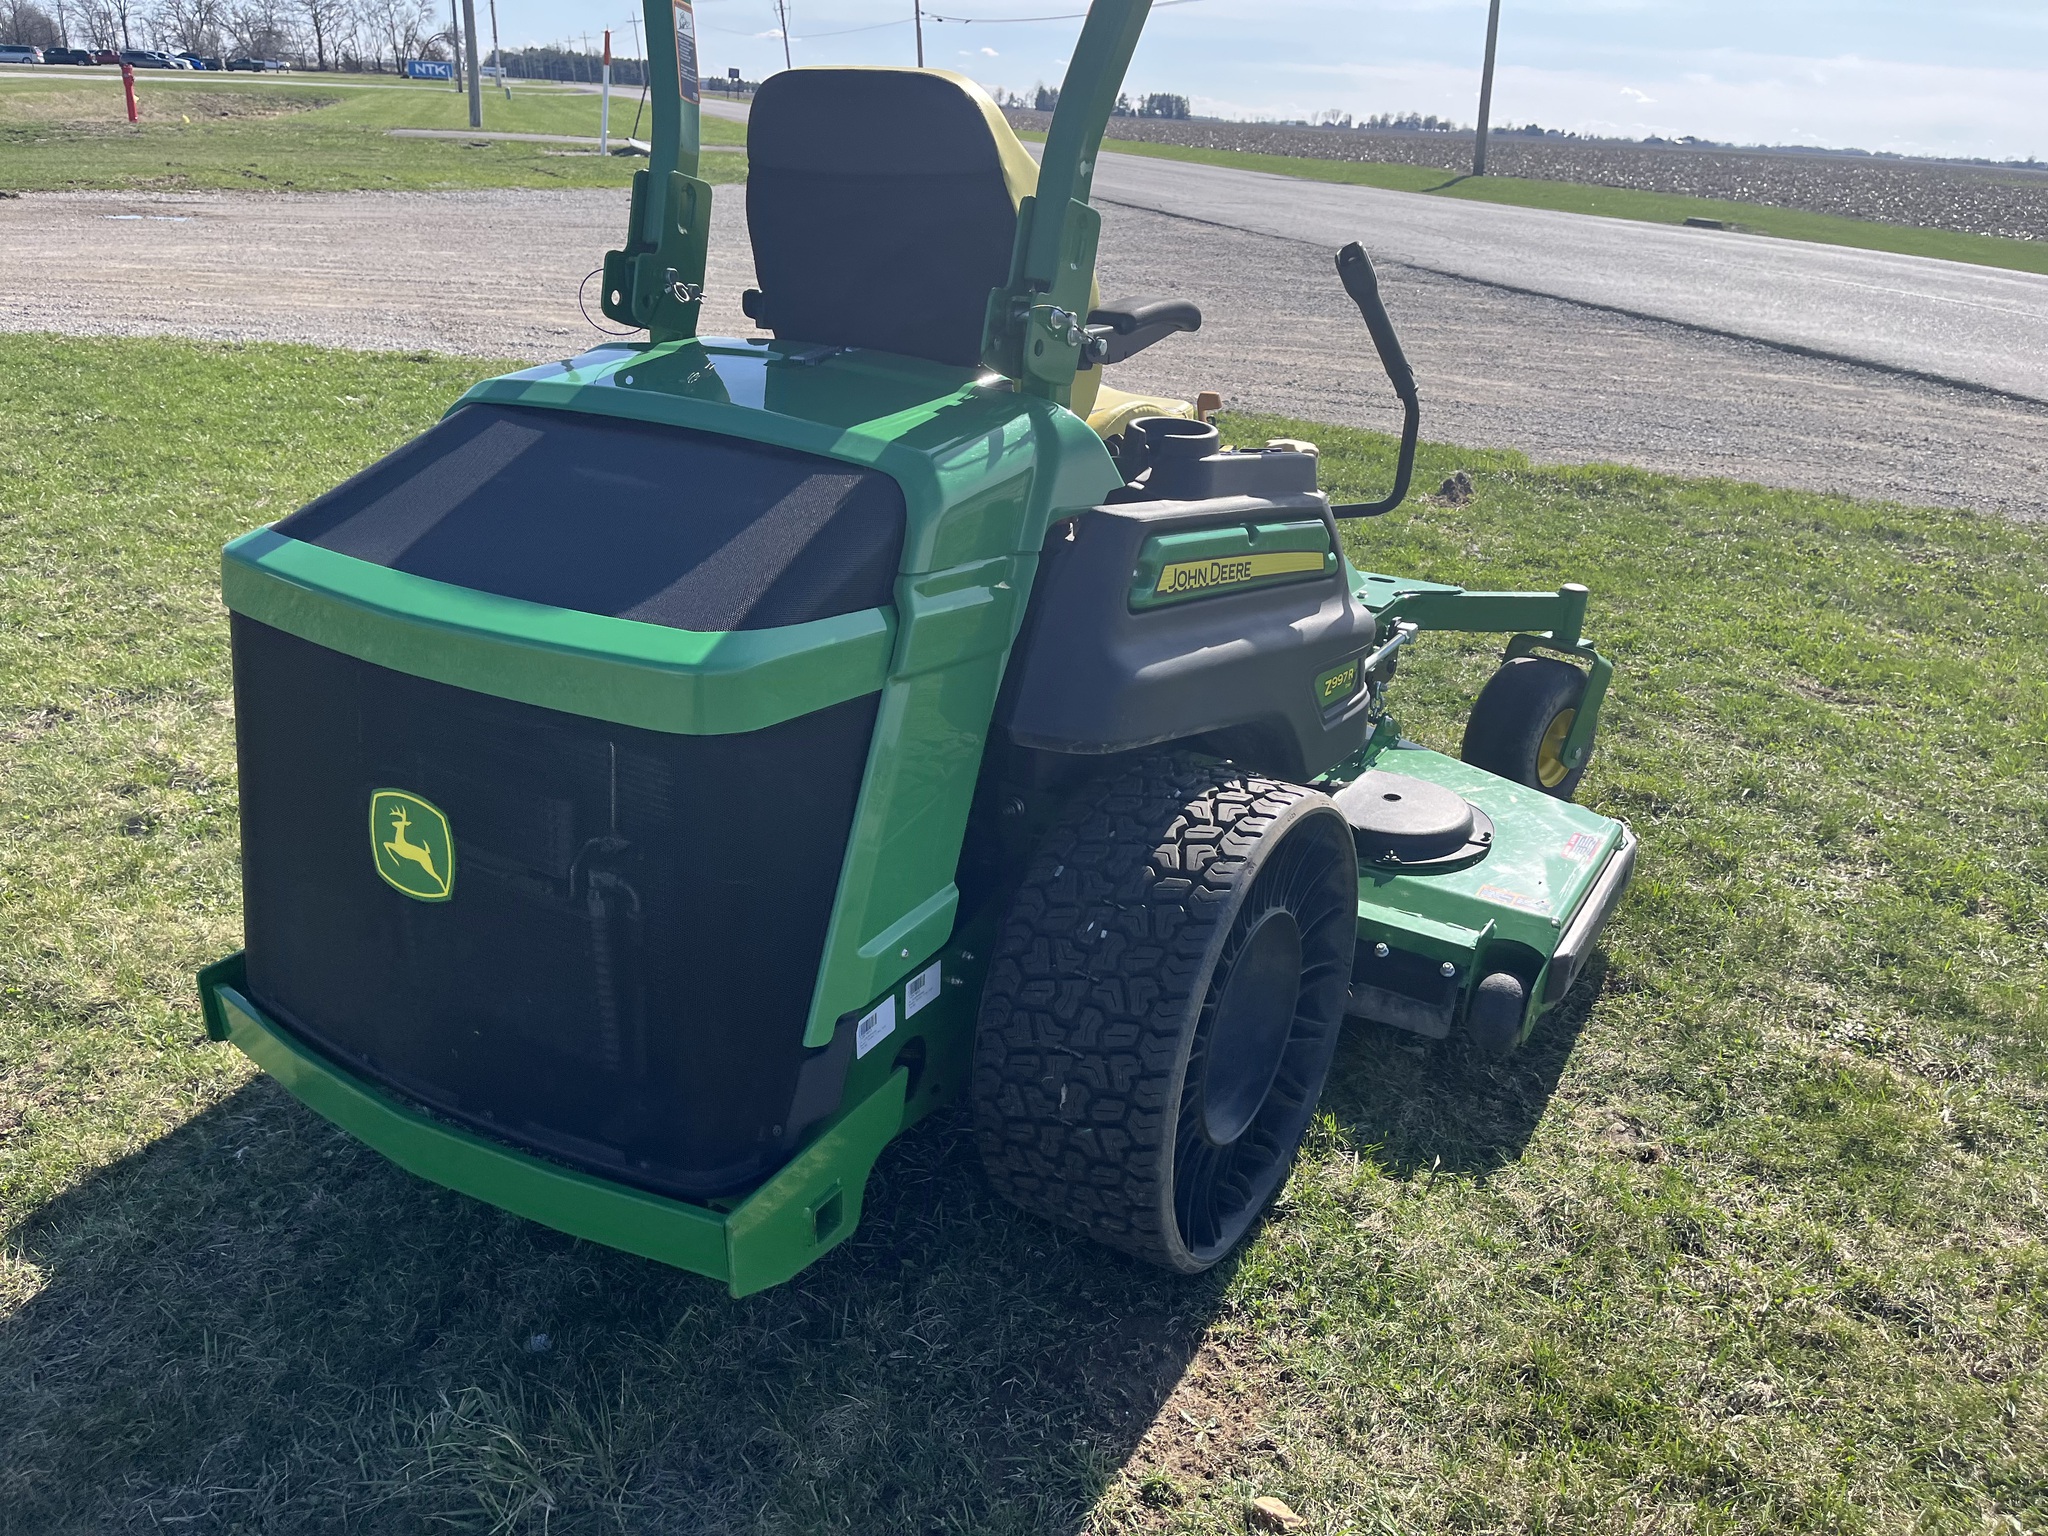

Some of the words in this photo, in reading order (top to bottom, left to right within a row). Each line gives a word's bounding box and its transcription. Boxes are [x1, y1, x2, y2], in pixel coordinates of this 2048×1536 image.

[414, 63, 447, 75] NTK
[1168, 567, 1208, 590] JOHN
[1210, 561, 1252, 583] DEERE
[1324, 668, 1354, 697] Z997R
